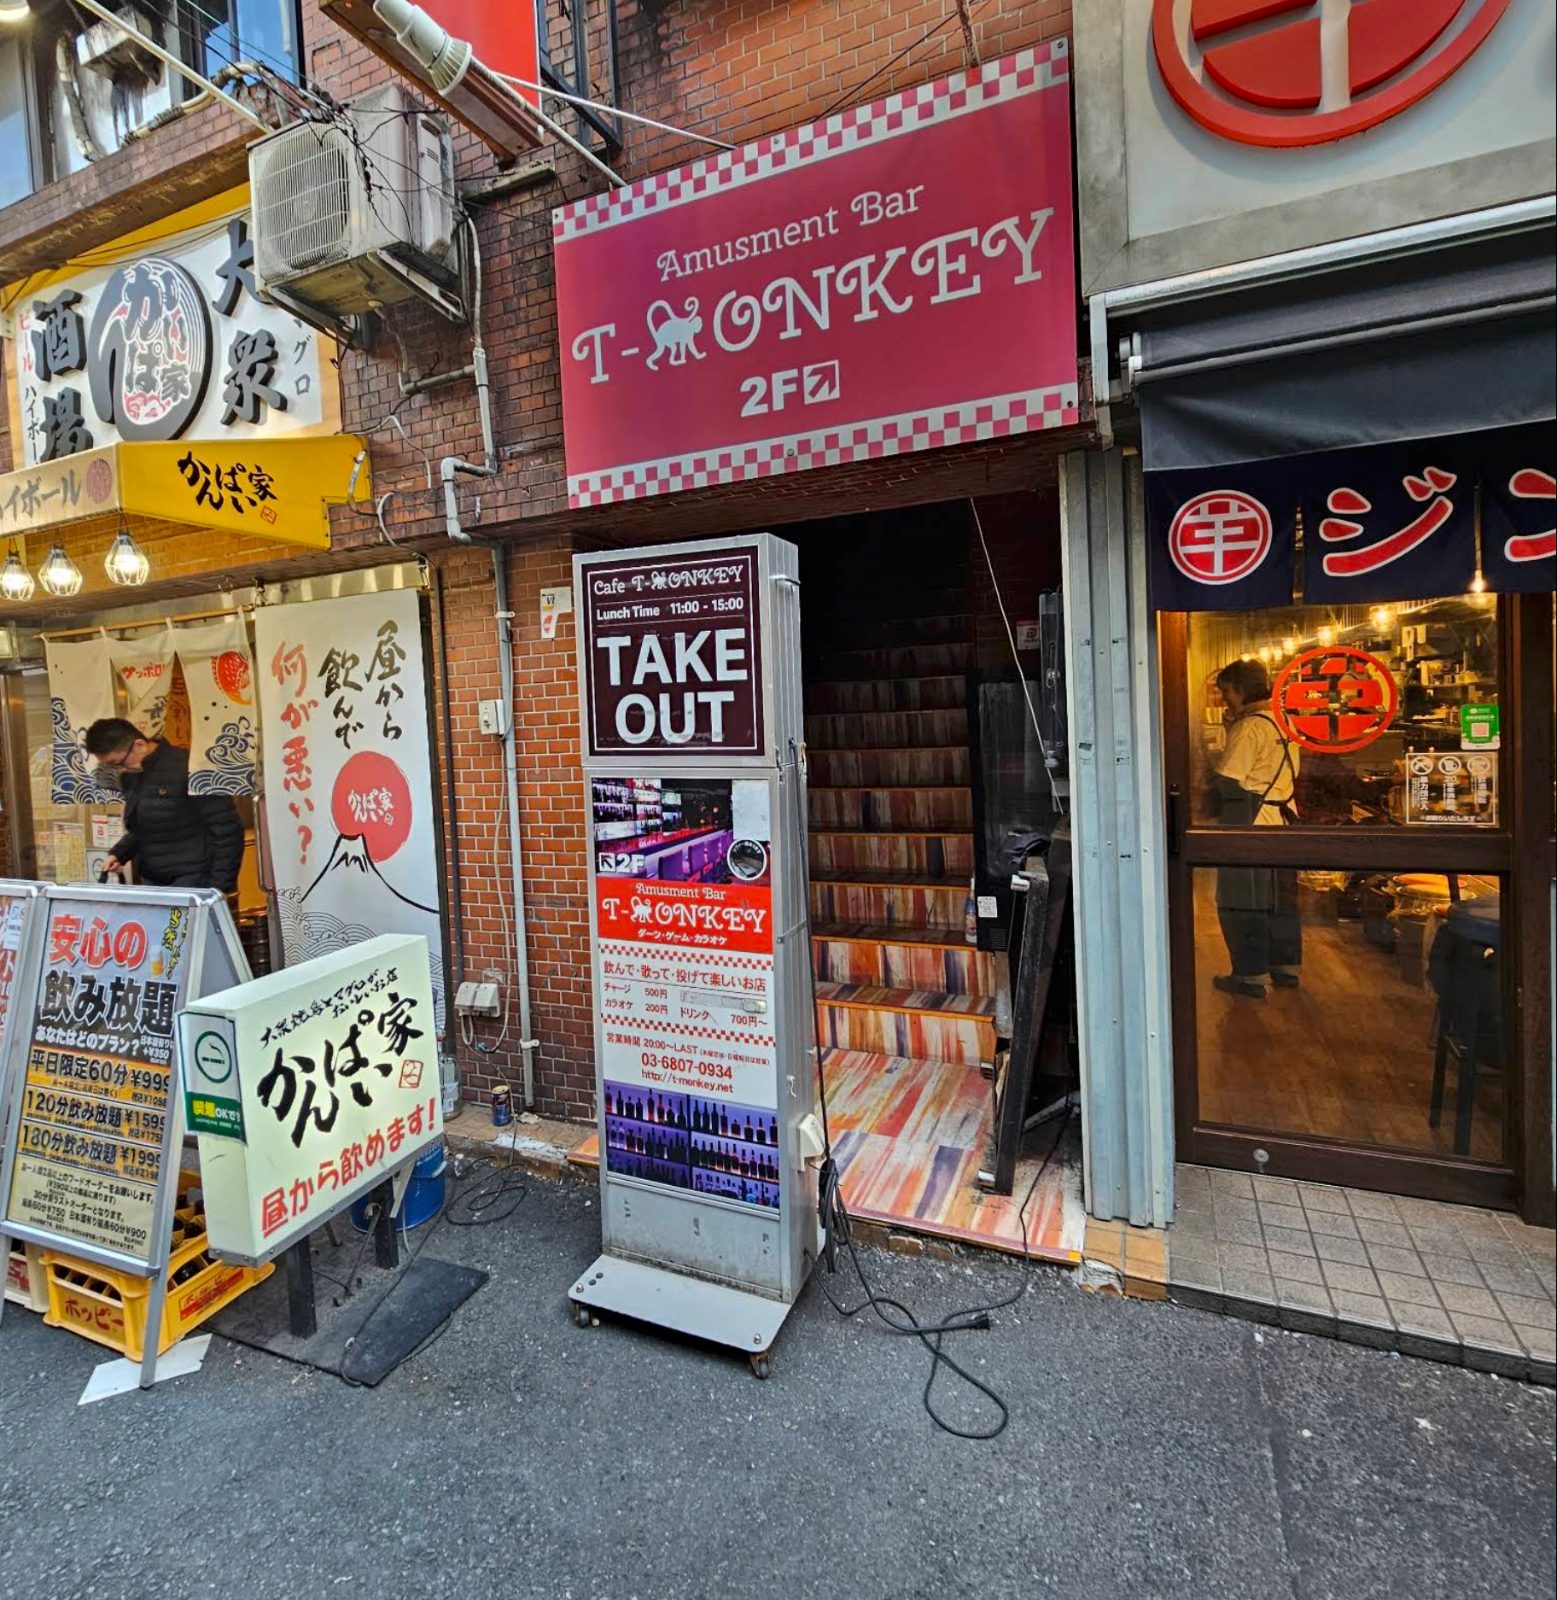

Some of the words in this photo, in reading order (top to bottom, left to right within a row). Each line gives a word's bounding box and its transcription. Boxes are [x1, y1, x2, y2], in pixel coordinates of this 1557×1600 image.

[657, 205, 839, 283] Amusment
[851, 184, 924, 228] Bar
[19, 311, 34, 373] ビール
[293, 318, 312, 395] グロ
[739, 368, 799, 418] 2F
[25, 385, 40, 464] ハイボー
[177, 451, 278, 514] かんぱい家
[594, 579, 626, 596] Cafe
[596, 605, 631, 621] Lunch
[632, 604, 660, 619] Time
[669, 600, 700, 615] 11:00
[711, 597, 744, 612] 15:00
[596, 628, 748, 687] TAKE
[318, 646, 364, 749] 飲んで
[365, 619, 406, 742] 昼から
[615, 690, 735, 745] OUT
[272, 640, 319, 866] 何が悪い？
[616, 853, 646, 874] 2F
[635, 882, 700, 899] Amusment
[702, 887, 727, 901] Bar
[49, 914, 148, 970] 安心の
[603, 960, 767, 993] 飲んで・歌って・投げて楽しいお店
[603, 981, 632, 994] チャージ
[644, 987, 668, 999] 500円
[40, 970, 178, 1037] 飲み放題
[604, 998, 634, 1010] カラオケ
[645, 1003, 668, 1015] 200円
[680, 1007, 710, 1021] ドリンク
[606, 1032, 641, 1048] 営業時間
[31, 1048, 129, 1086] 平日限定60分
[257, 991, 425, 1148] かんぱい家
[641, 1052, 733, 1080] 03-6807-0934
[641, 1069, 734, 1093] http://t-monkey.net
[27, 1090, 122, 1128] 120分飲み放題
[64, 1296, 124, 1331] ホッピー
